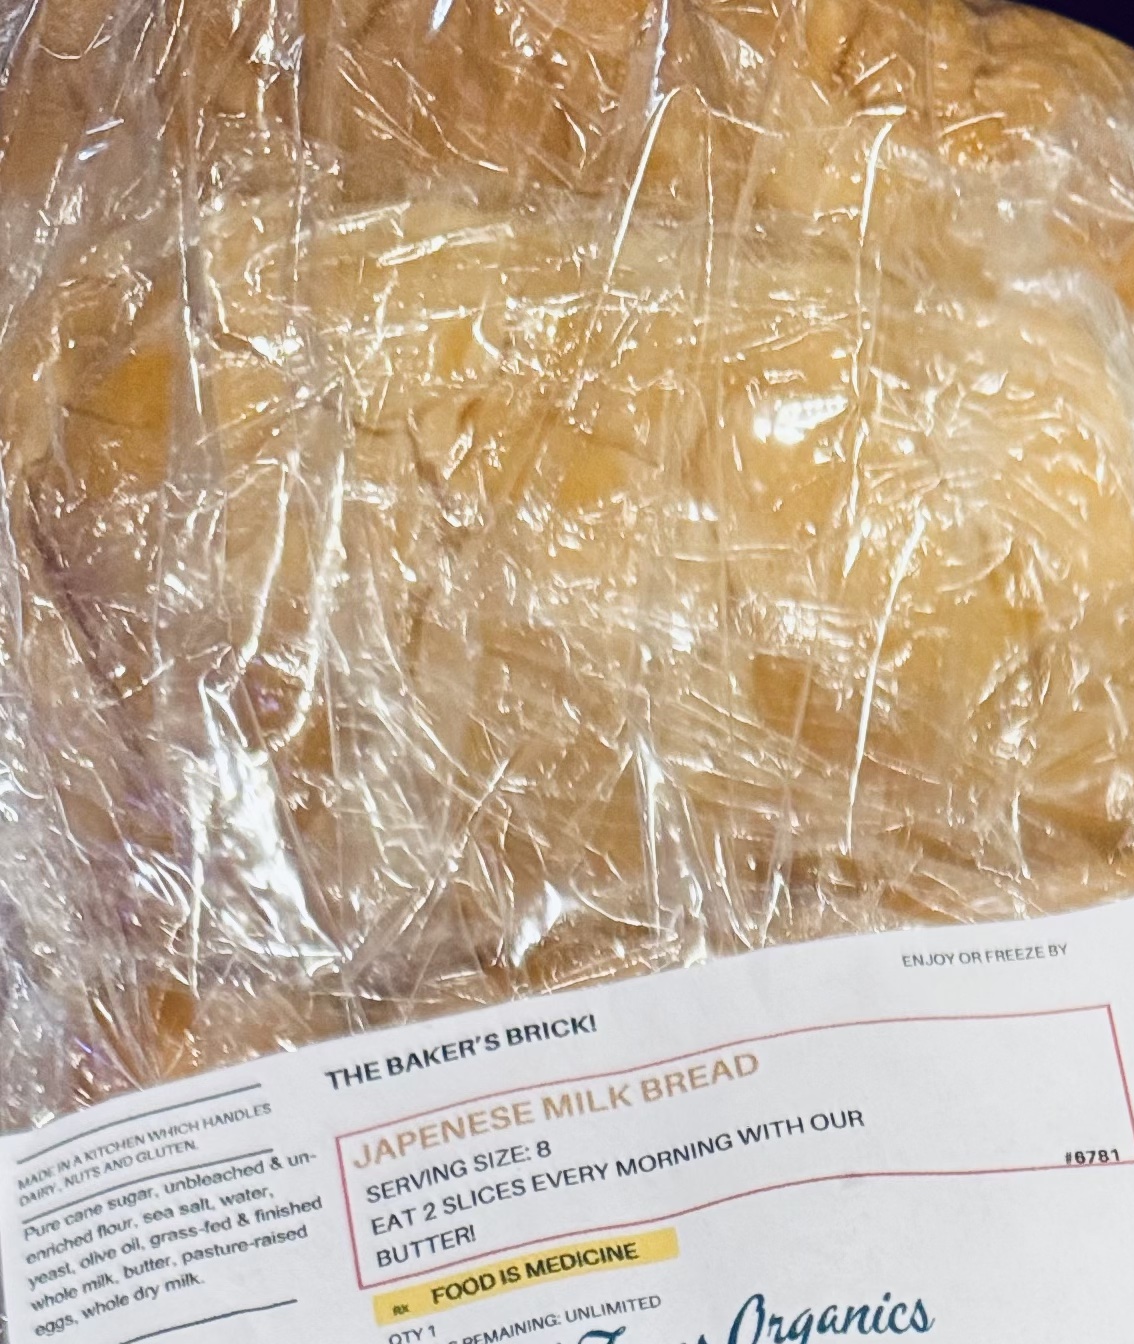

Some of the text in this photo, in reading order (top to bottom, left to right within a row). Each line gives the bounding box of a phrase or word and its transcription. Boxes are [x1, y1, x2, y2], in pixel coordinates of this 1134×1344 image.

[902, 943, 1068, 968] ENJOY OR FREEZE BY
[324, 1014, 597, 1092] THE BAKER'S BRICK!
[351, 1051, 761, 1170] JAPENESE MILK BREAD
[17, 1103, 272, 1191] MADE IN A KITCHEN WHICH HANDLES
[64, 1167, 101, 1188] NUTS
[103, 1154, 133, 1174] AND
[365, 1139, 553, 1204] SERVING SIZE: 8
[371, 1109, 866, 1237] EAT 2 SLICES EVERY MORNING WITH OUR
[1065, 1149, 1120, 1165] #6781
[23, 1219, 60, 1242] Pure
[65, 1204, 103, 1225] cane
[164, 1163, 265, 1195] unbleached
[270, 1156, 283, 1170] &
[288, 1151, 317, 1168] un-
[25, 1230, 94, 1265] enriched
[97, 1217, 139, 1240] flour,
[143, 1208, 174, 1224] sea
[220, 1187, 274, 1208] water,
[28, 1196, 323, 1291] yeast, olive oil, grass-fed & finished
[31, 1286, 78, 1312] whole
[123, 1255, 177, 1279] butter,
[182, 1225, 308, 1265] pasture-raised
[376, 1224, 478, 1268] BUTTER!
[430, 1272, 497, 1306] FOOD
[501, 1265, 521, 1286] IS
[525, 1242, 640, 1279] MEDICINE
[35, 1271, 205, 1337] eggs, whole dry milk.
[428, 1325, 437, 1339] 1
[565, 1294, 662, 1323] UNLIMITED
